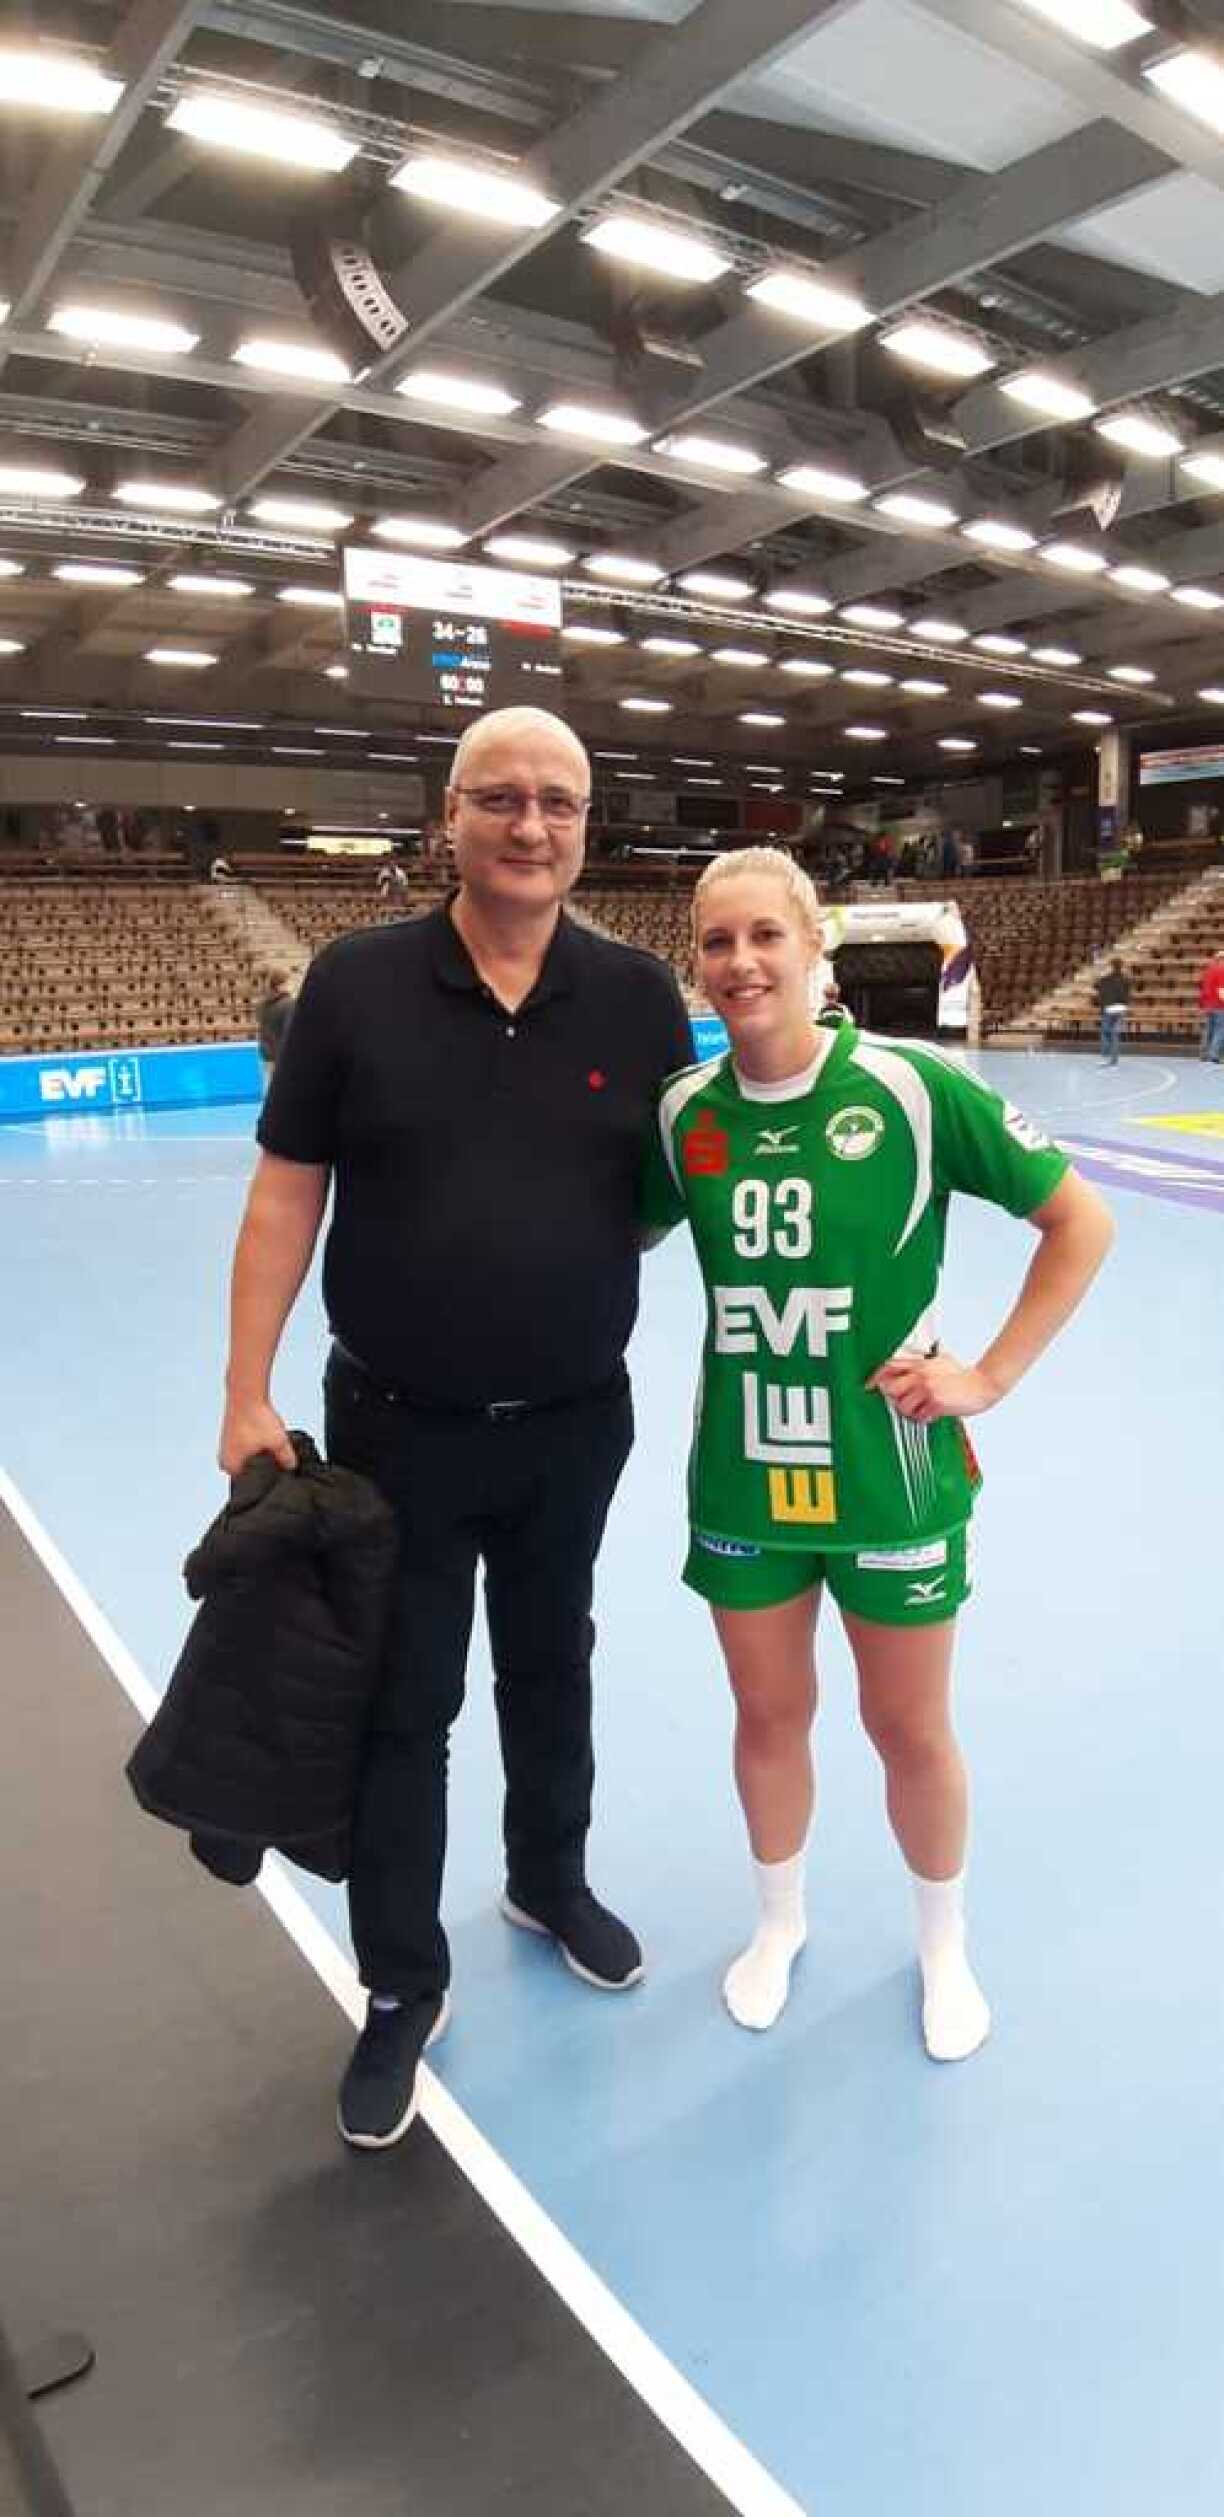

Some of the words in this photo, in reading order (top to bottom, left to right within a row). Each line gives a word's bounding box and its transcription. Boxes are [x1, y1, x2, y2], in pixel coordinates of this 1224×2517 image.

[40, 1066, 106, 1101] EVF
[732, 1178, 813, 1259] 93
[713, 1285, 854, 1358] EVF
